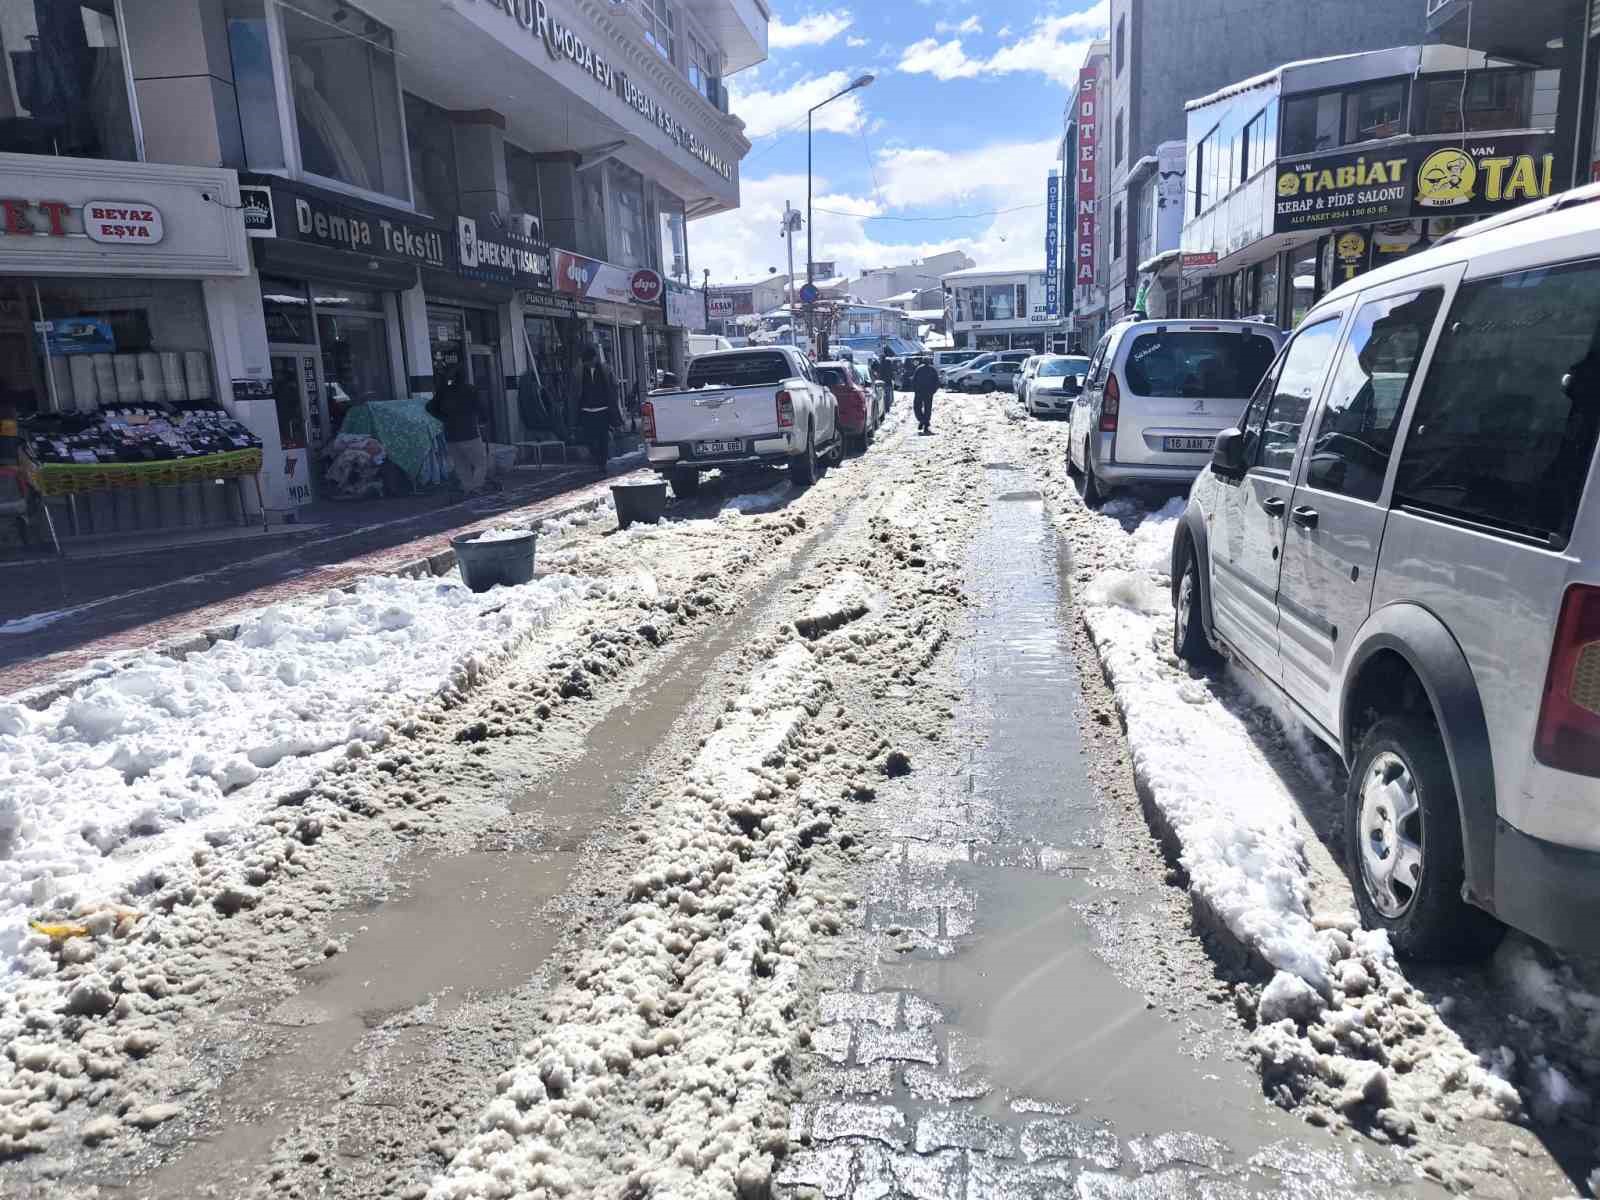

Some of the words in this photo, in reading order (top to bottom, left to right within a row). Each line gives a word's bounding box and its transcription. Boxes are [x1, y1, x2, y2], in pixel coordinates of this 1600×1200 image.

[553, 19, 593, 73] MODA
[1470, 146, 1496, 156] VAN
[1295, 163, 1312, 172] VAN
[1301, 156, 1408, 193] TABİAT
[1277, 199, 1313, 214] KEBAP
[1316, 198, 1325, 209] &
[1328, 192, 1354, 207] PİDE
[1358, 186, 1405, 203] SALONU
[91, 207, 154, 222] BEYAZ
[101, 224, 150, 239] EŞYA
[296, 198, 371, 250] Dempa
[379, 219, 443, 262] Tekstil
[567, 257, 588, 289] dyo
[634, 278, 657, 292] dyo
[1171, 440, 1181, 448] 16
